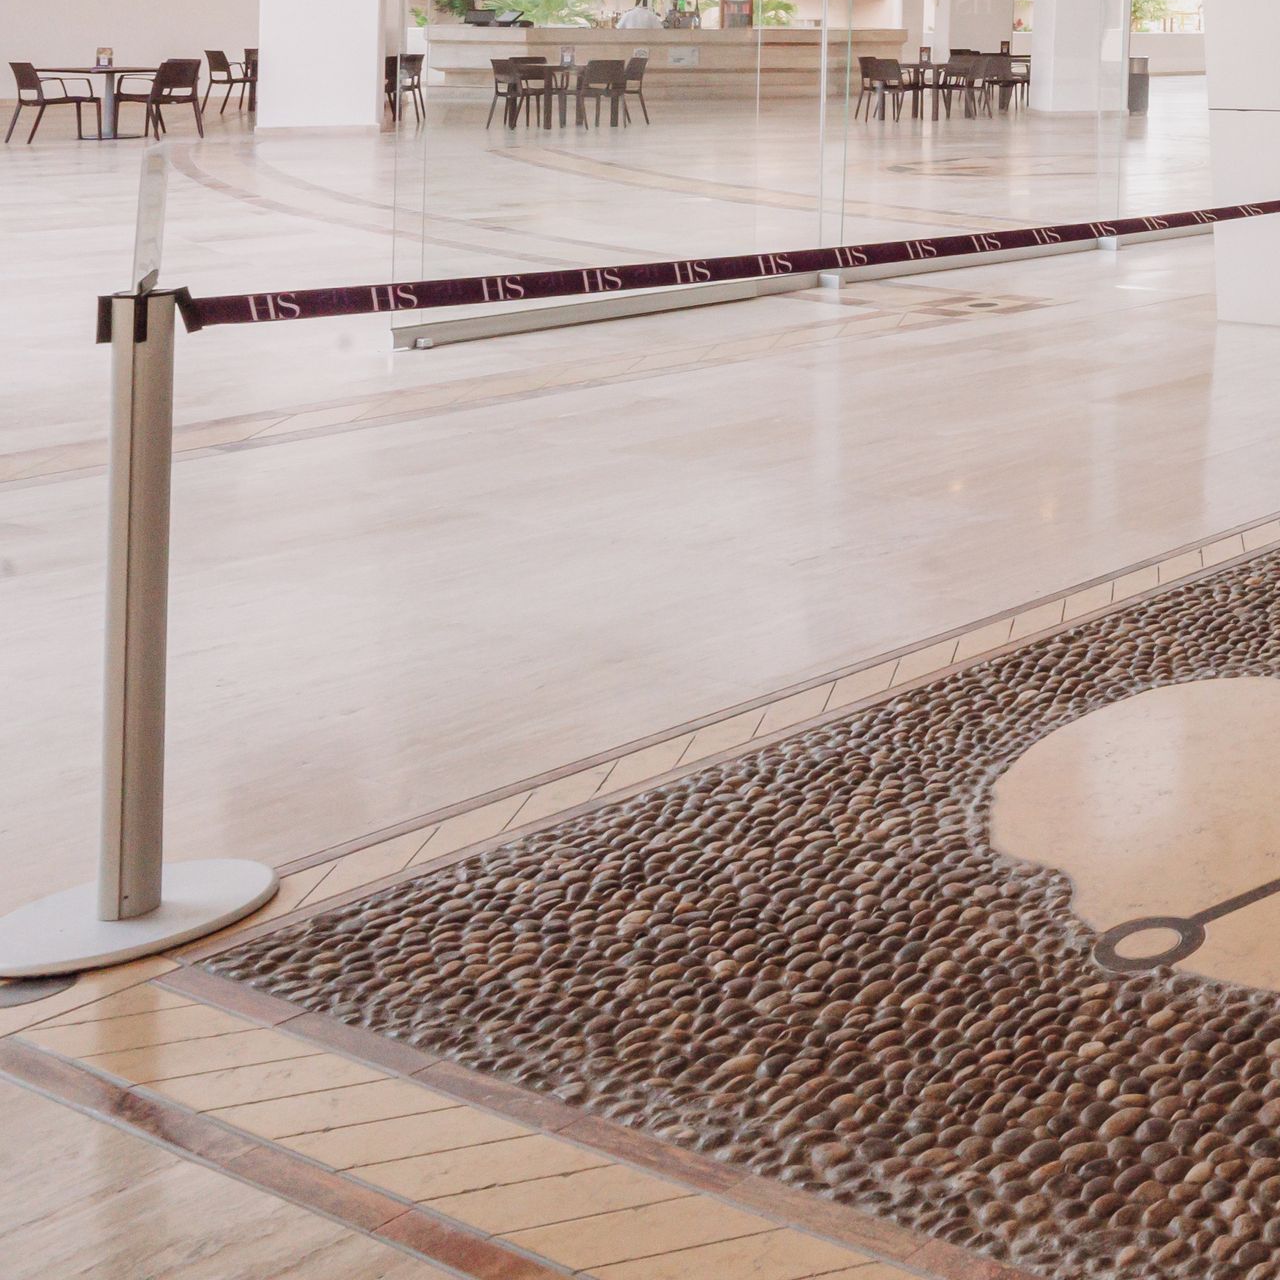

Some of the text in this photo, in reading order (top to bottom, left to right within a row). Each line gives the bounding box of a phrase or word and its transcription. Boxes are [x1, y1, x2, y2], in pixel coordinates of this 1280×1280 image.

[248, 292, 301, 321] HS
[370, 284, 418, 312] HS
[481, 276, 525, 302] HS
[581, 267, 622, 293] HS
[673, 260, 711, 284] HS
[757, 253, 793, 275] HS
[833, 246, 868, 267] HS
[905, 239, 938, 260] HS
[970, 233, 1001, 253] HS
[1031, 228, 1062, 246] HS
[1088, 221, 1118, 238] HS
[1142, 216, 1169, 231] HS
[1191, 211, 1219, 224] HS
[1238, 205, 1264, 217] HS
